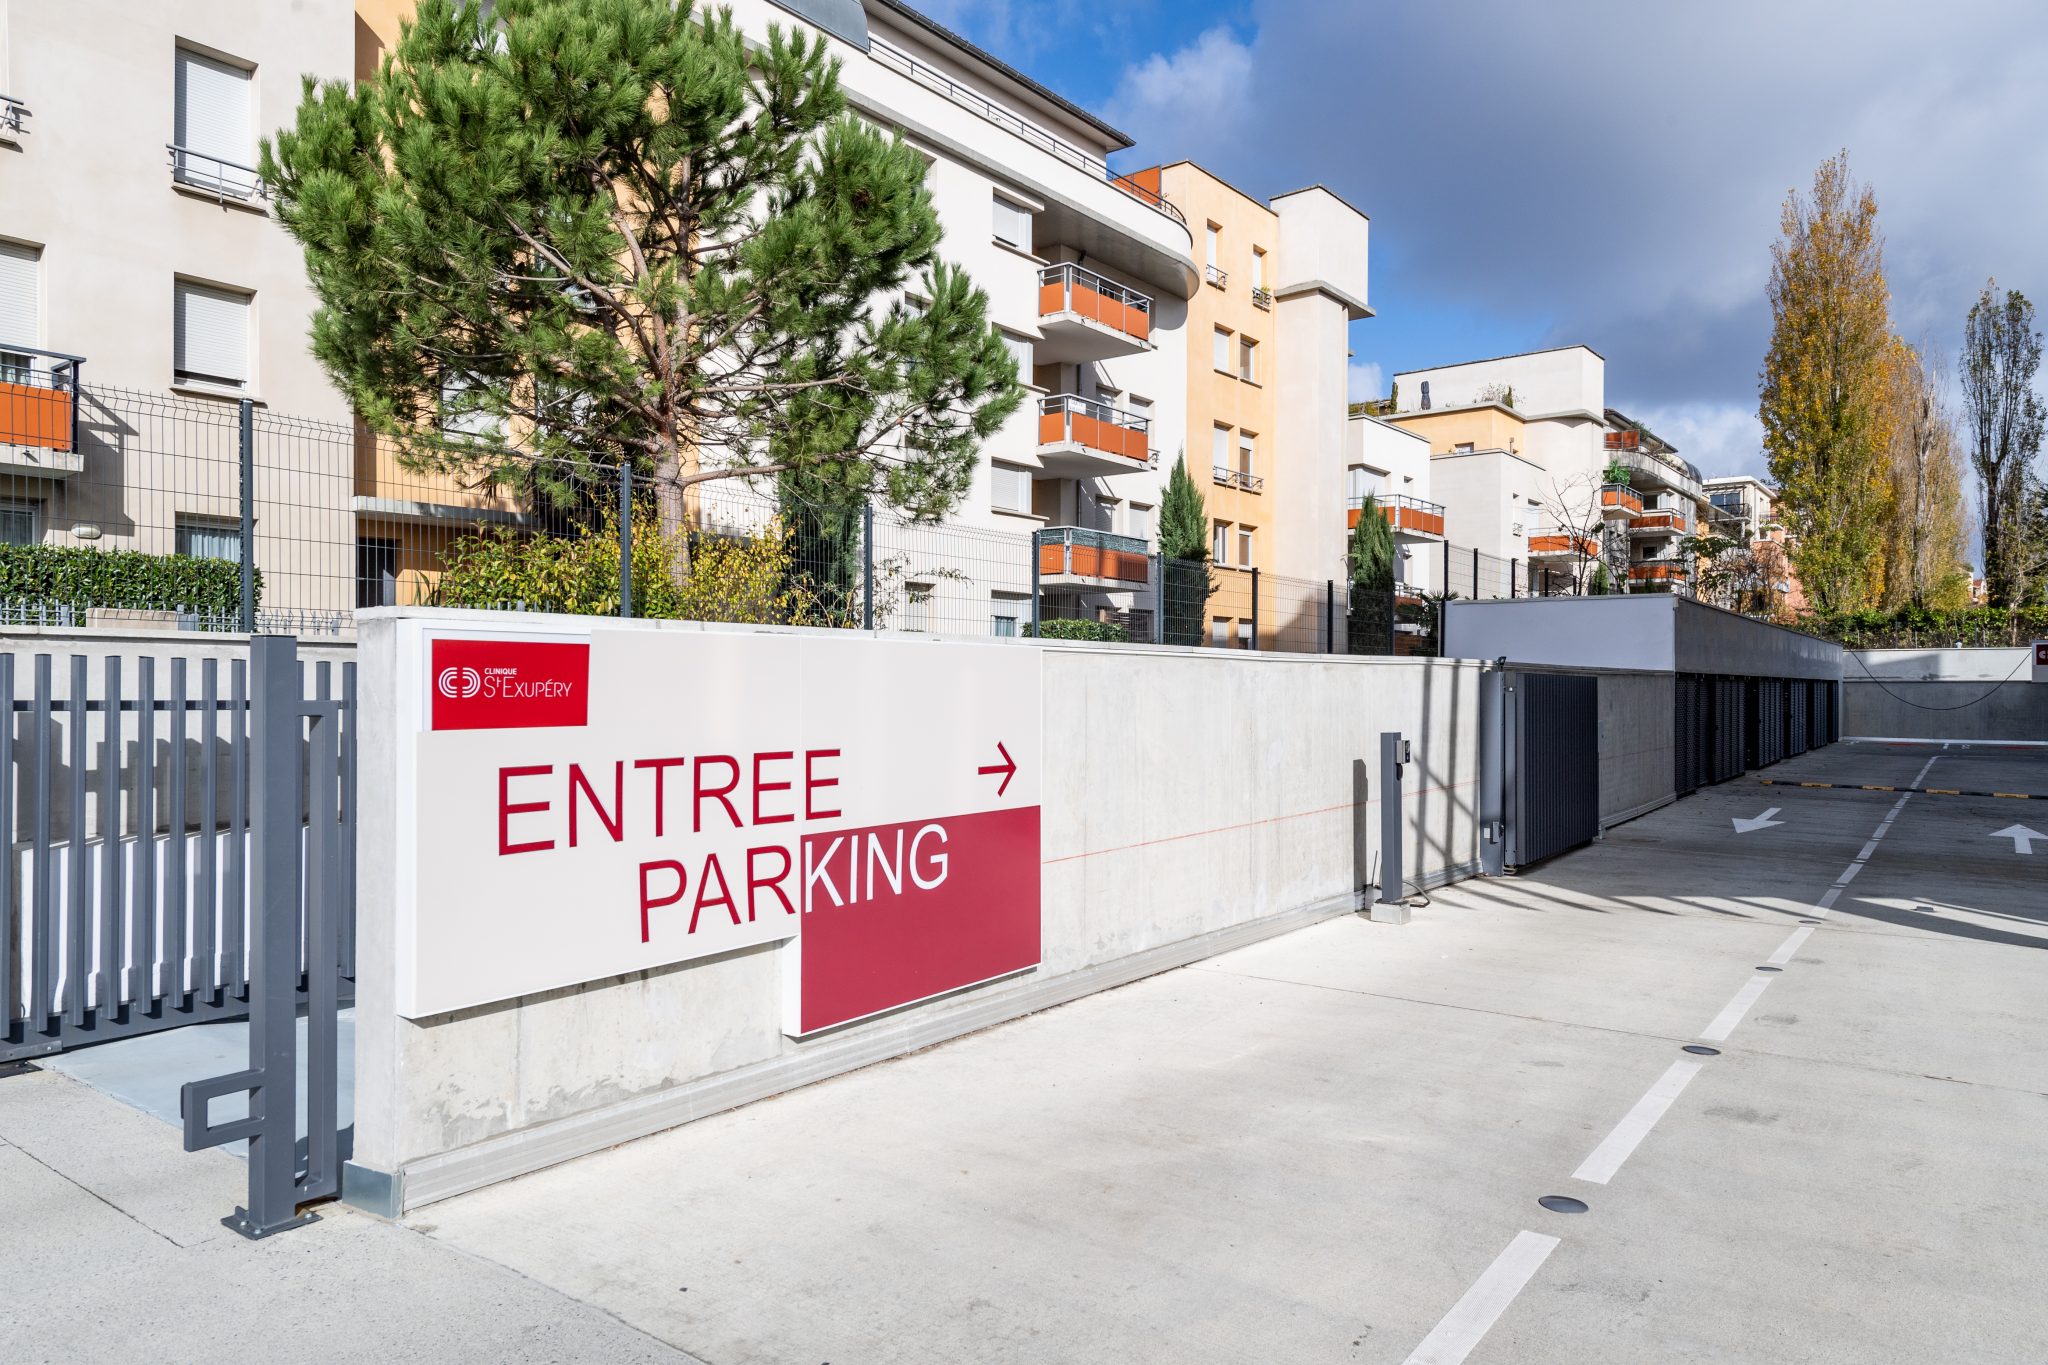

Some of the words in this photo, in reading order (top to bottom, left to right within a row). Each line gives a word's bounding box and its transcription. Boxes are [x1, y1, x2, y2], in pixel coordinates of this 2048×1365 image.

[484, 667, 518, 675] CLINIQUE
[498, 747, 842, 856] ENTREE
[638, 823, 949, 944] PARKING
